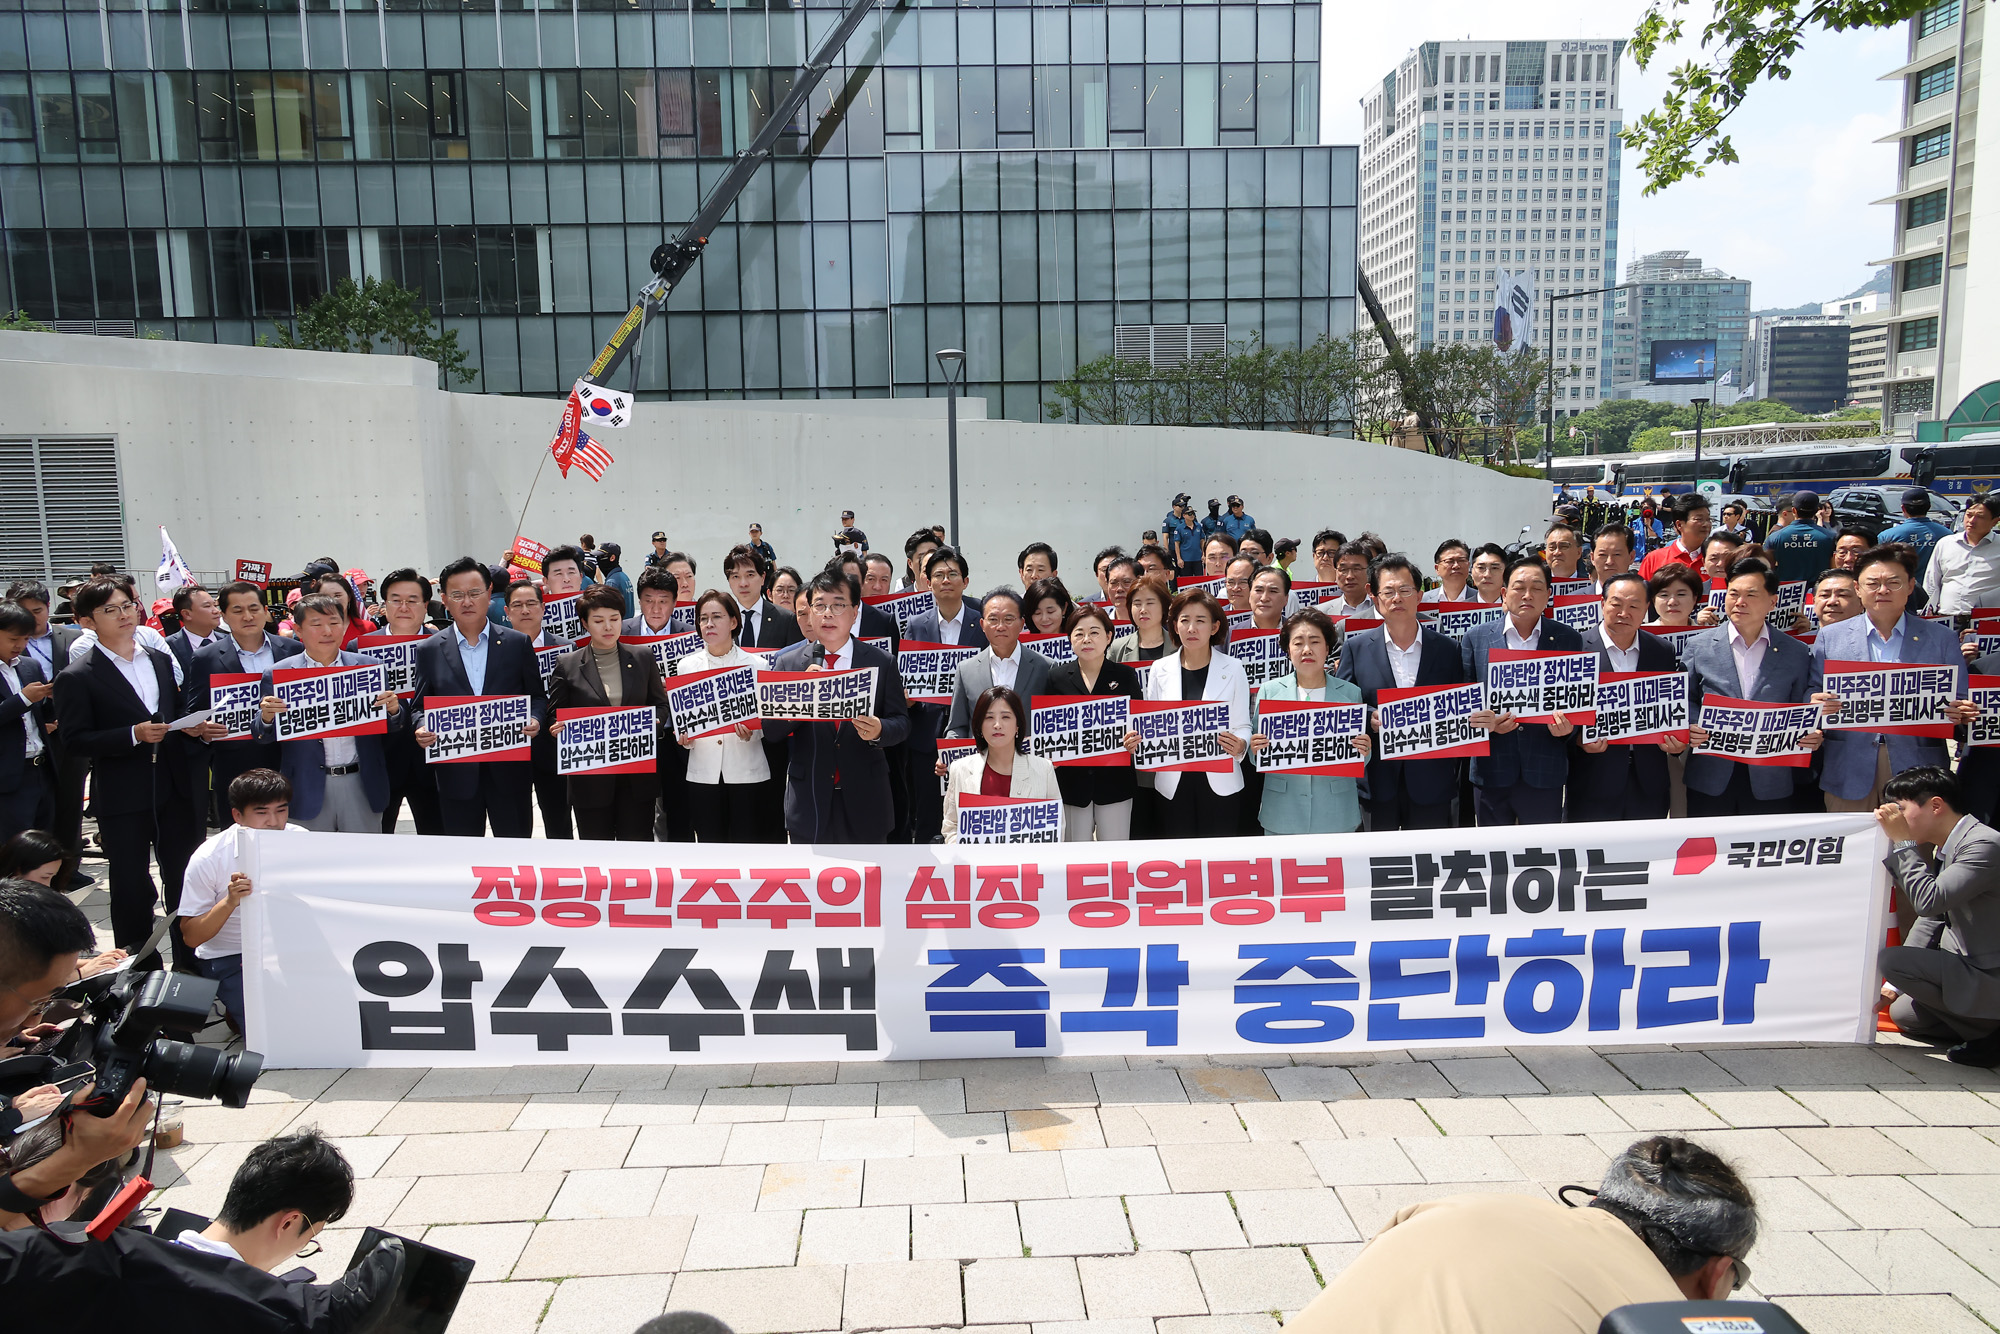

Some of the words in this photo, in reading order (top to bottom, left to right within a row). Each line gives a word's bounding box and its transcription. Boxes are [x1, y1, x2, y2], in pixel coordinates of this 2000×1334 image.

[1561, 41, 1588, 52] 외교부
[1784, 541, 1818, 549] POLICE
[240, 562, 261, 573] 가짜
[899, 652, 940, 674] 야당탄압
[1491, 662, 1542, 689] 야당탄압
[1544, 656, 1596, 685] 정치보복
[277, 678, 329, 710] 민주주의
[332, 668, 382, 700] 파괴특검
[672, 680, 716, 713] 야당탄압
[716, 668, 755, 699] 정치보복
[760, 682, 815, 703] 야당탄압
[818, 671, 871, 702] 정치보복
[1490, 688, 1540, 715] 압수수색
[1543, 683, 1595, 711] 중단하라
[1597, 683, 1630, 711] 주주의
[1634, 675, 1686, 705] 파괴특검
[1827, 673, 1886, 699] 민주주의
[1890, 669, 1953, 696] 파괴특검
[279, 704, 331, 736] 당원명부
[333, 695, 383, 725] 절대사수
[427, 705, 477, 733] 야당탄압
[479, 698, 528, 726] 정치보복
[676, 702, 721, 734] 압수수색
[720, 692, 758, 723] 중단하라
[761, 702, 814, 720] 압수수색
[817, 696, 871, 719] 중단하라
[1034, 706, 1080, 735] 야당탄압
[1081, 698, 1127, 729] 정치보복
[1132, 711, 1179, 740] 야당탄압
[1182, 705, 1230, 735] 정치보복
[1261, 712, 1312, 740] 야당탄압
[1313, 707, 1364, 737] 정치보복
[1382, 701, 1431, 729] 야당탄압
[1433, 687, 1483, 717] 정치보복
[1634, 703, 1686, 732] 절대사수
[1701, 708, 1760, 733] 민주주의
[1760, 706, 1819, 733] 파괴특검
[1889, 696, 1951, 722] 절대사수
[429, 730, 478, 759] 압수수색
[480, 722, 528, 751] 중단하라
[560, 717, 606, 745] 야당탄압
[608, 709, 653, 738] 정치보복
[1383, 724, 1433, 755] 압수수색
[560, 740, 606, 771] 압수수색
[608, 734, 655, 763] 중단하라
[1034, 731, 1079, 759] 압수수색
[1135, 737, 1180, 766] 압수수색
[1260, 739, 1309, 768] 압수수색
[960, 808, 1007, 835] 야당탄압
[1010, 802, 1059, 833] 정치보복
[1727, 836, 1845, 867] 국민의힘
[471, 865, 881, 929] 정당민주주의
[905, 863, 1044, 929] 심장
[1066, 857, 1346, 929] 당원명부
[1369, 847, 1650, 920] 탈취하는
[352, 940, 877, 1052] 압수수색
[925, 943, 1189, 1048] 즉각
[1234, 921, 1770, 1045] 중단하라
